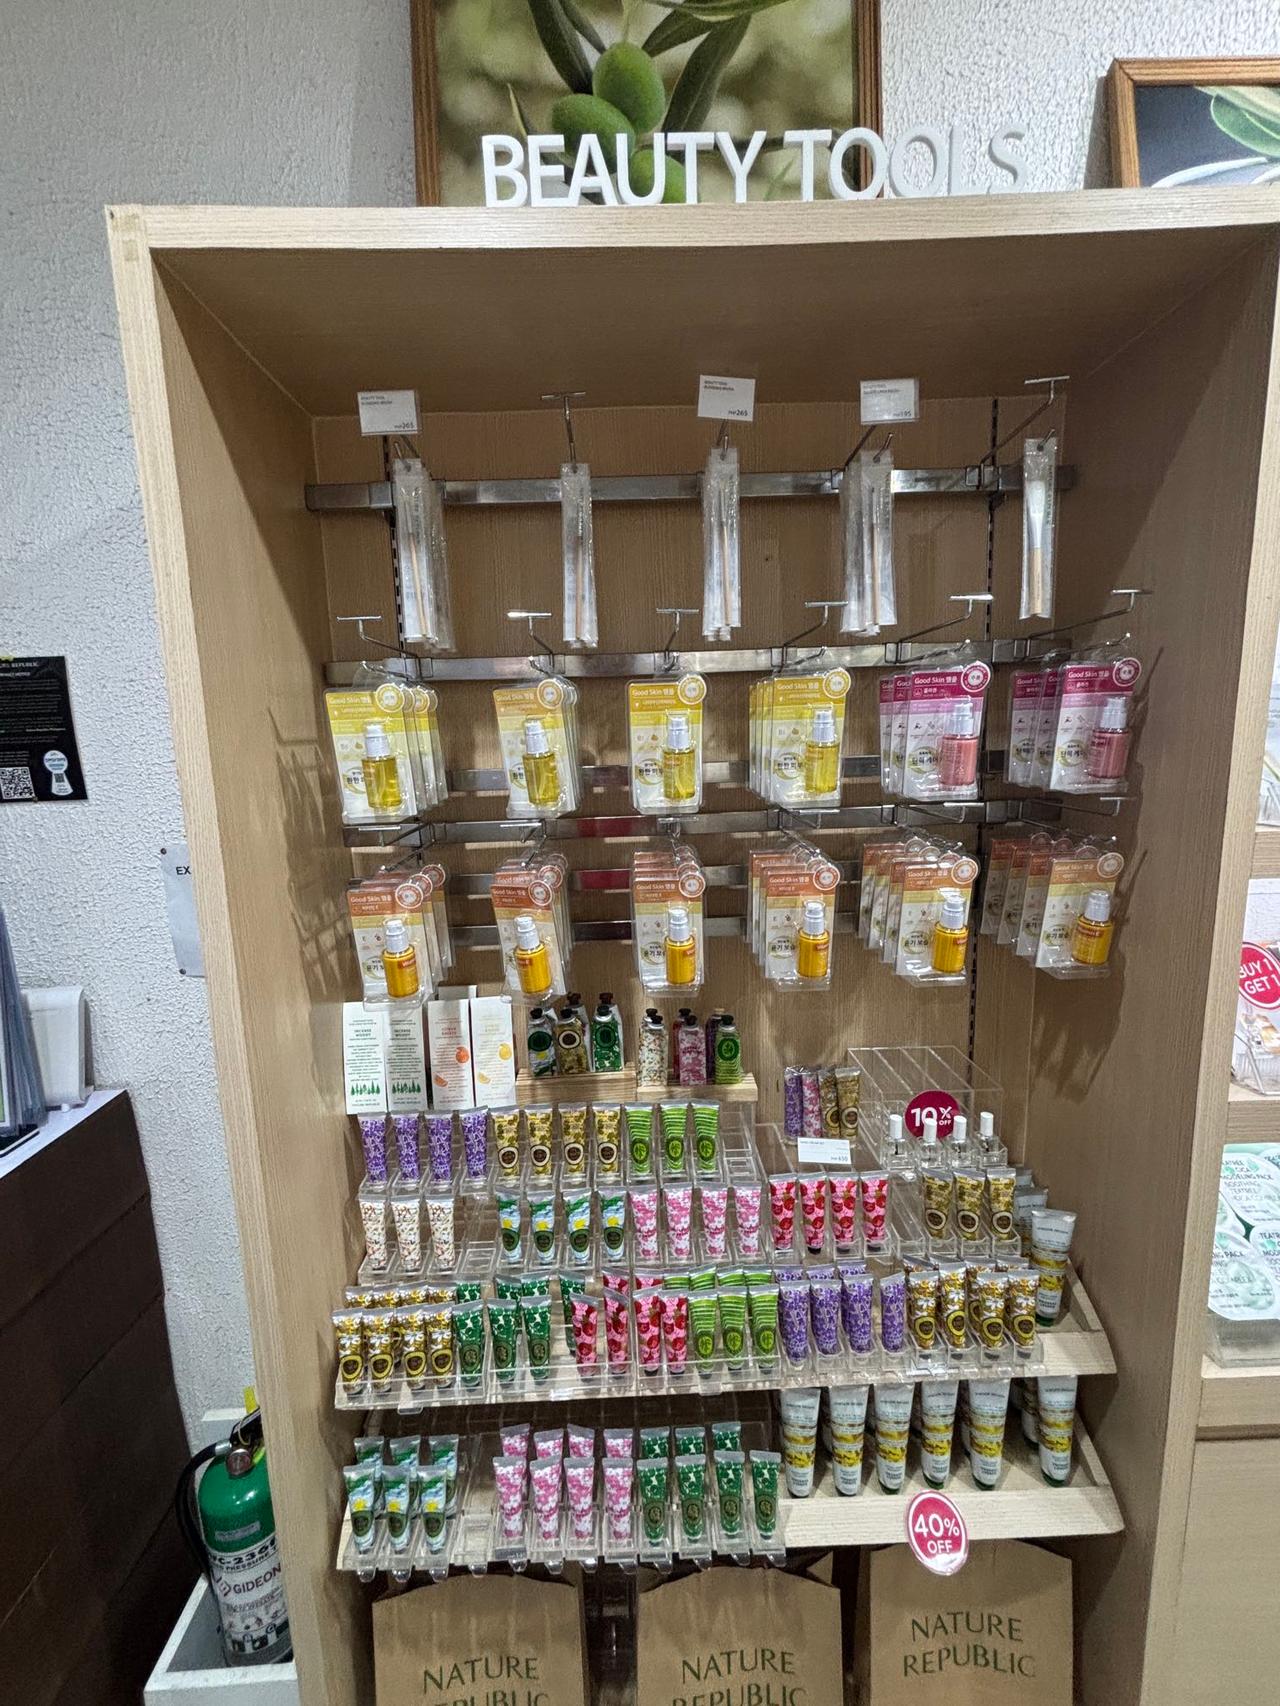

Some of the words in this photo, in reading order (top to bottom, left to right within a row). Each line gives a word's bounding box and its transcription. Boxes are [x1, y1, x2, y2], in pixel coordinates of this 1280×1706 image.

[482, 131, 766, 207] BEAUTY
[783, 127, 1026, 202] TOOLS
[931, 676, 945, 684] Skin
[1068, 671, 1084, 679] Good
[632, 688, 648, 696] Good
[649, 688, 662, 696] Skin
[1240, 960, 1262, 979] BUY
[1263, 958, 1273, 971] 1
[1244, 976, 1271, 994] GET
[914, 1513, 960, 1538] 40%
[927, 1540, 953, 1554] OFF
[233, 1562, 282, 1594] GIDEON
[910, 1610, 1024, 1643] NATURE
[682, 1648, 796, 1684] NATURE
[903, 1643, 1037, 1677] REPUBLIC
[423, 1655, 539, 1695] NATURE
